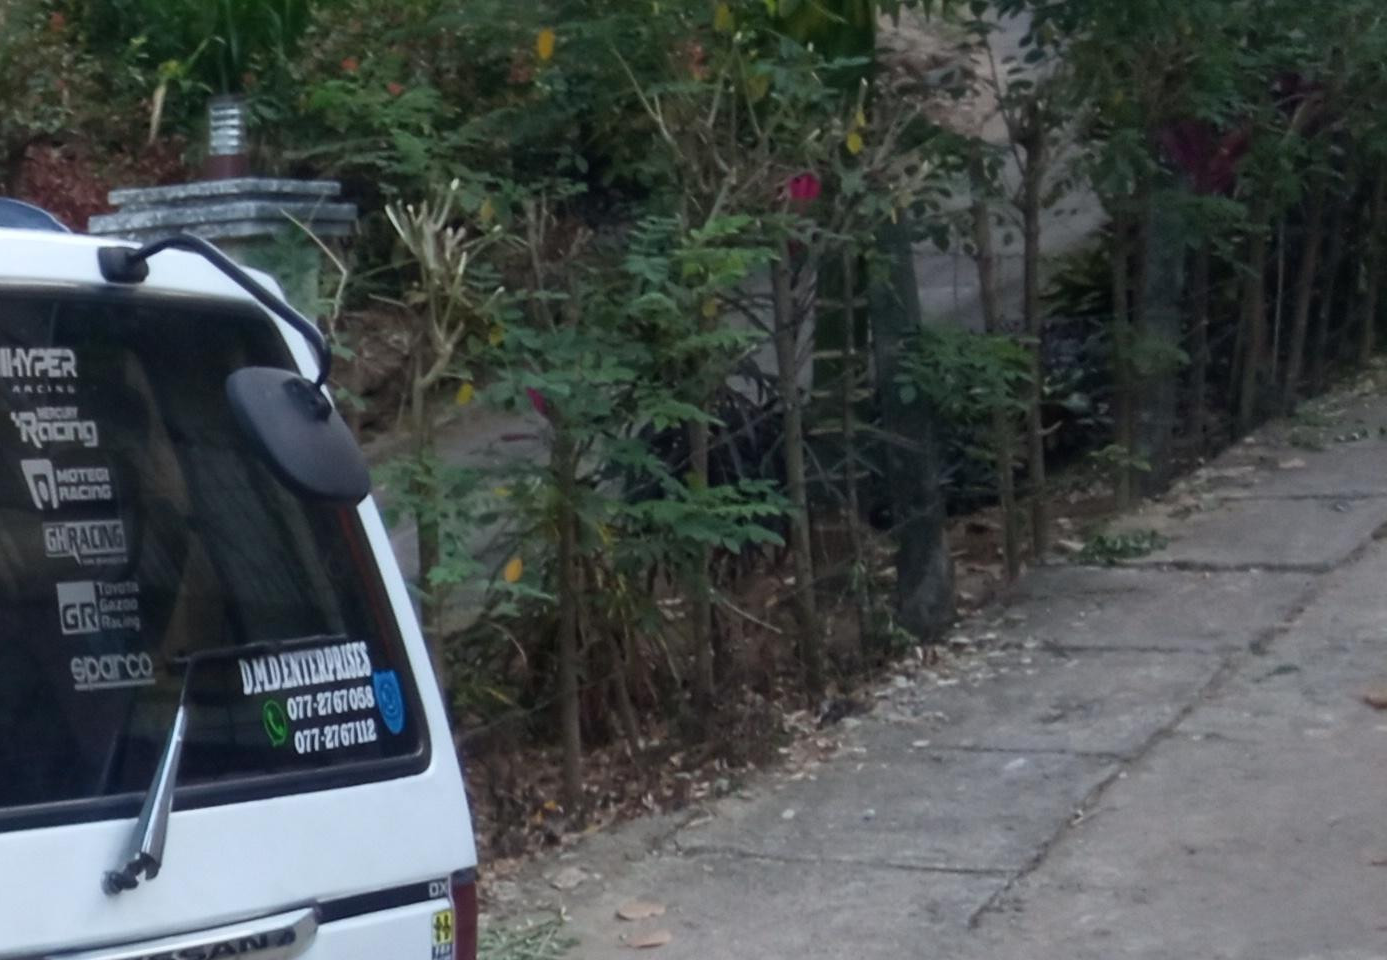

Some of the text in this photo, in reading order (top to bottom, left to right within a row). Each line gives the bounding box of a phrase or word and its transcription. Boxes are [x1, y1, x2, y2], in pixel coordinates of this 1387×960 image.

[11, 411, 99, 448] Racing
[58, 485, 112, 500] RACING
[62, 604, 97, 630] GR
